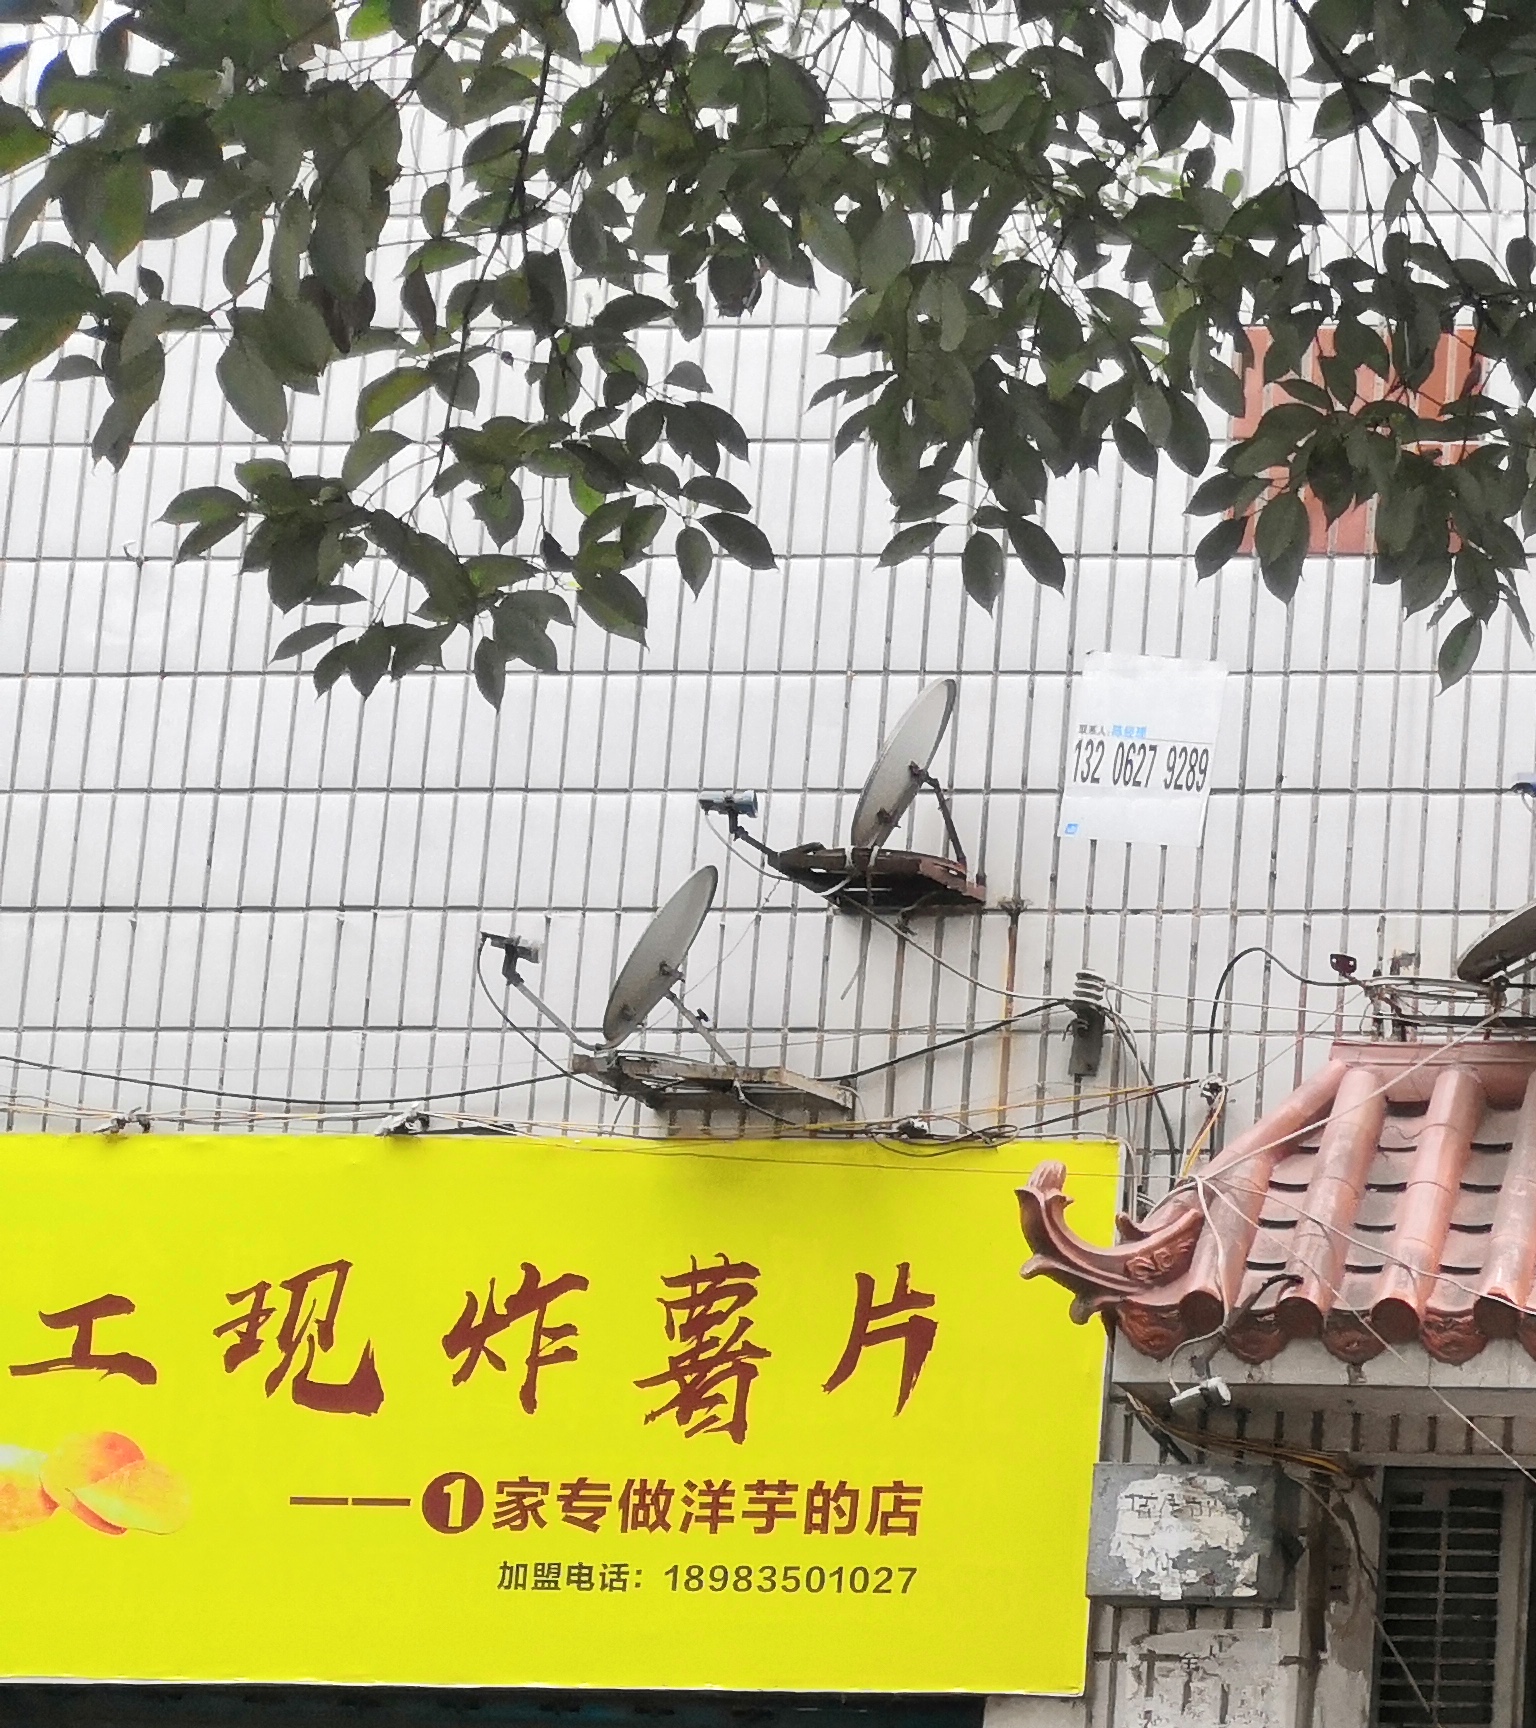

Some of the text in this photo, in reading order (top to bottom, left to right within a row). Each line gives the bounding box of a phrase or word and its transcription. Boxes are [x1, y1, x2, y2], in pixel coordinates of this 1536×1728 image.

[1073, 739, 1210, 792] 132 0627 9289
[8, 1253, 940, 1445] 工现炸薯片
